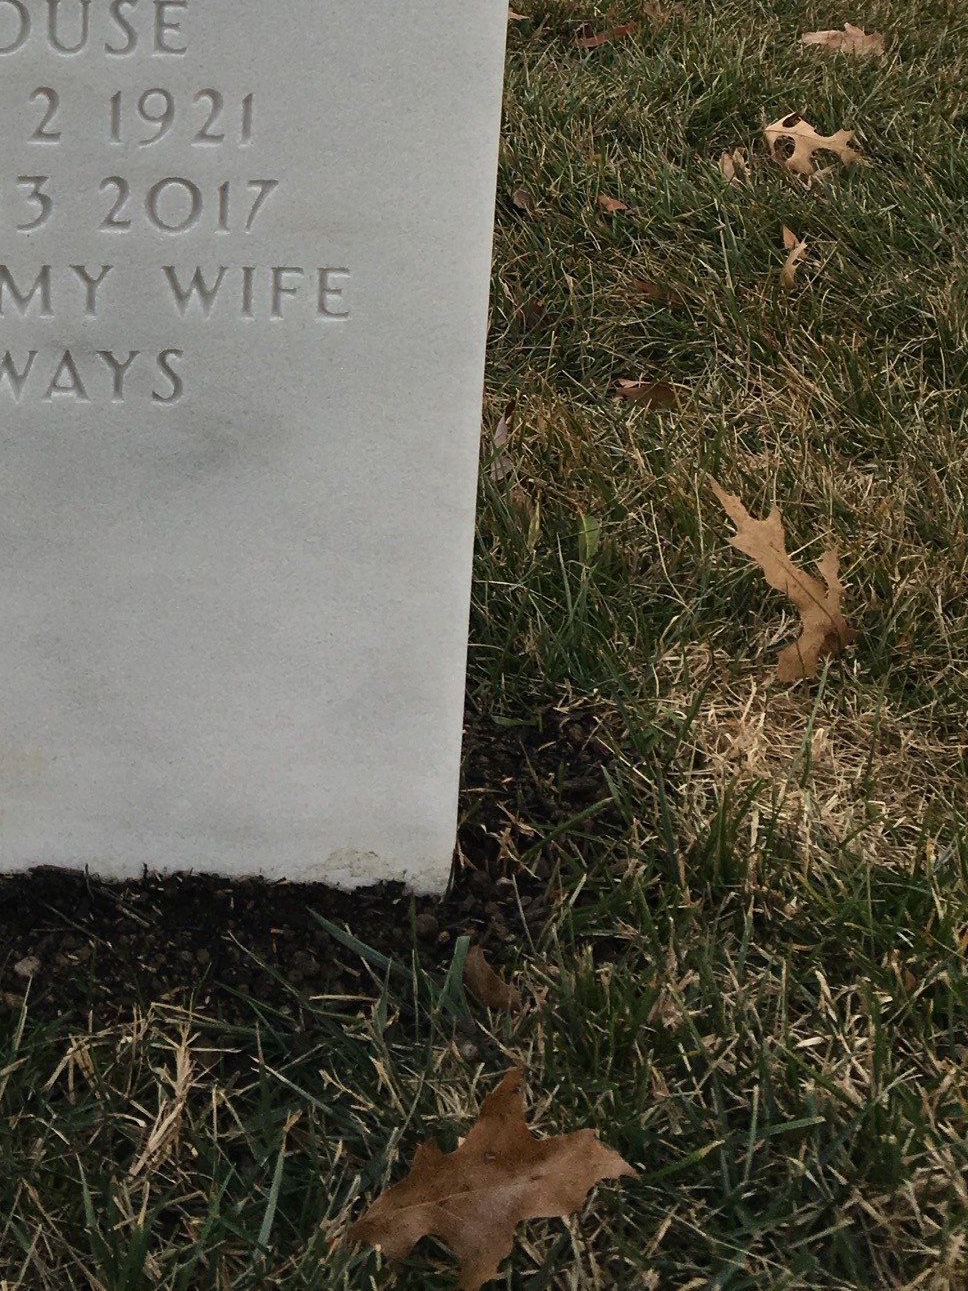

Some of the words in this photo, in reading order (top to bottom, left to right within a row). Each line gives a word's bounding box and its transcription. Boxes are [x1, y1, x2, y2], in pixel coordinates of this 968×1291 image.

[30, 87, 62, 142] 2
[109, 88, 255, 147] 1921
[98, 176, 278, 234] 2017
[162, 265, 351, 321] WIFE
